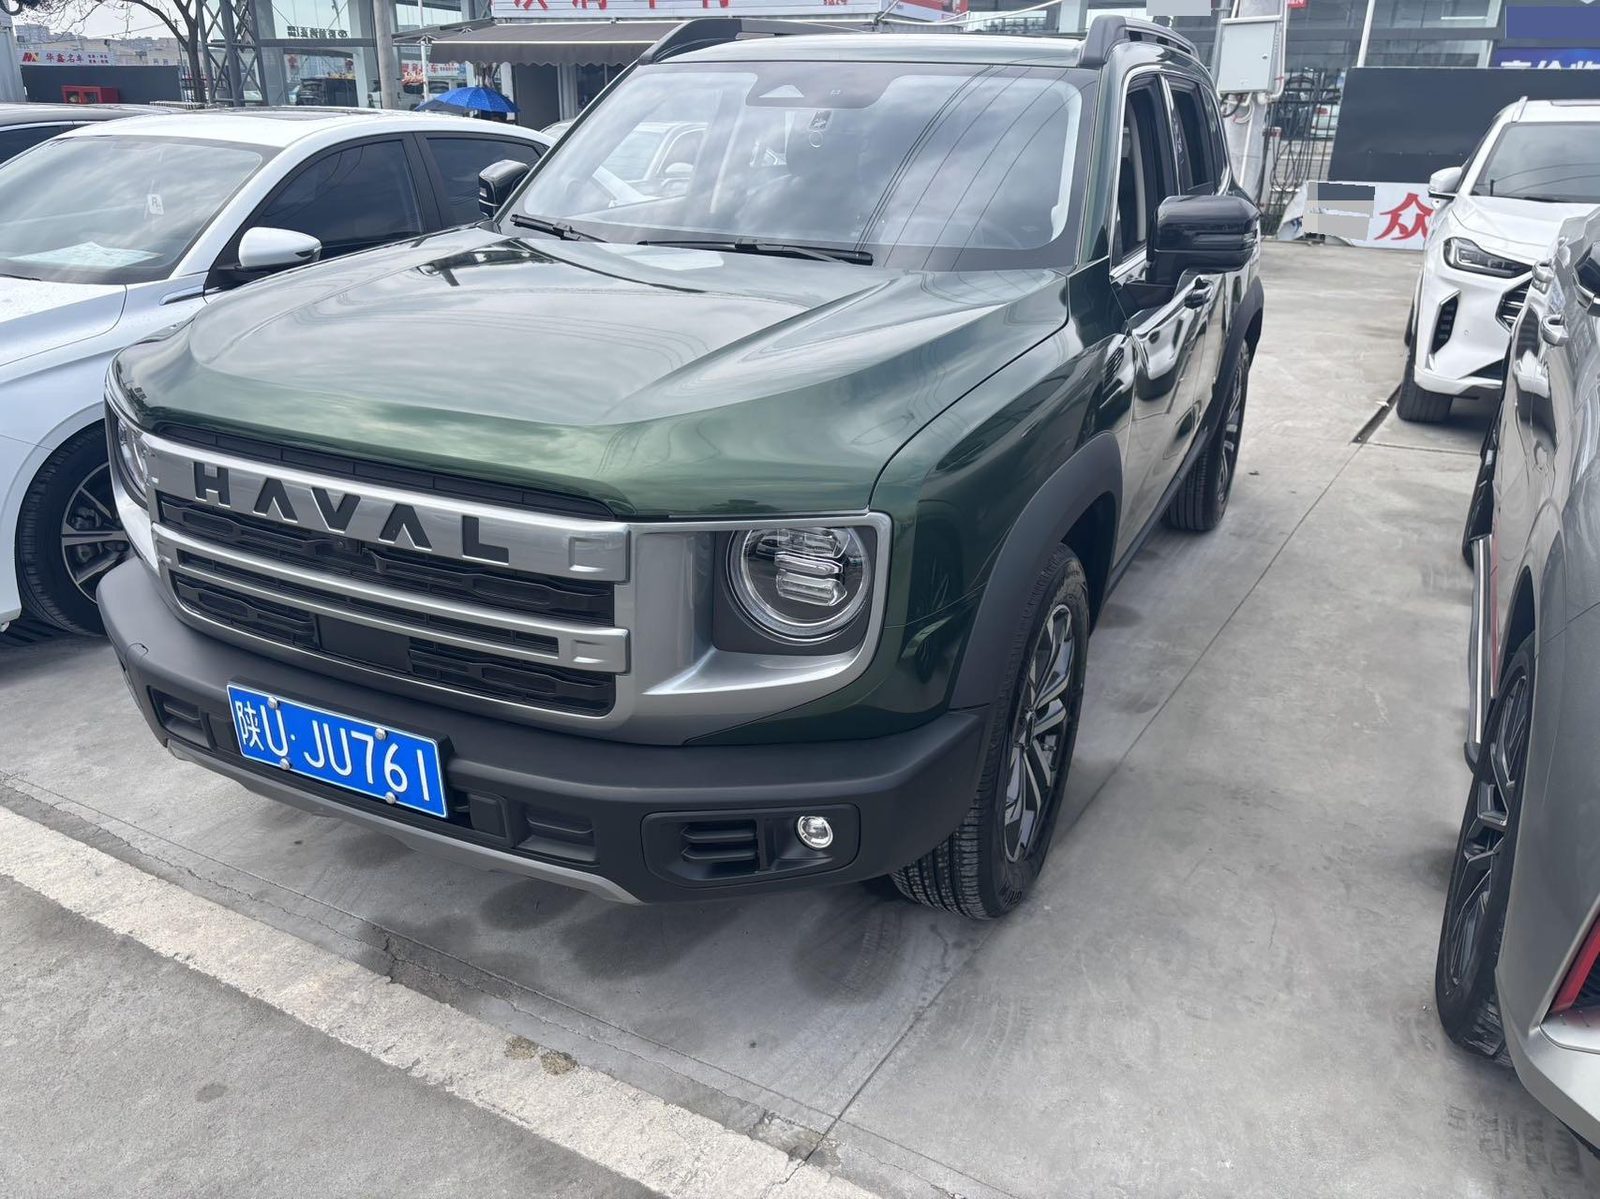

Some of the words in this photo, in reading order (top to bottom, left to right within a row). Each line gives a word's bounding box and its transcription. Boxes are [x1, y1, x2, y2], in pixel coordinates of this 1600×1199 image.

[1374, 192, 1434, 241] 众
[192, 460, 510, 566] HAVAL
[234, 700, 431, 802] 陕U·JU761
